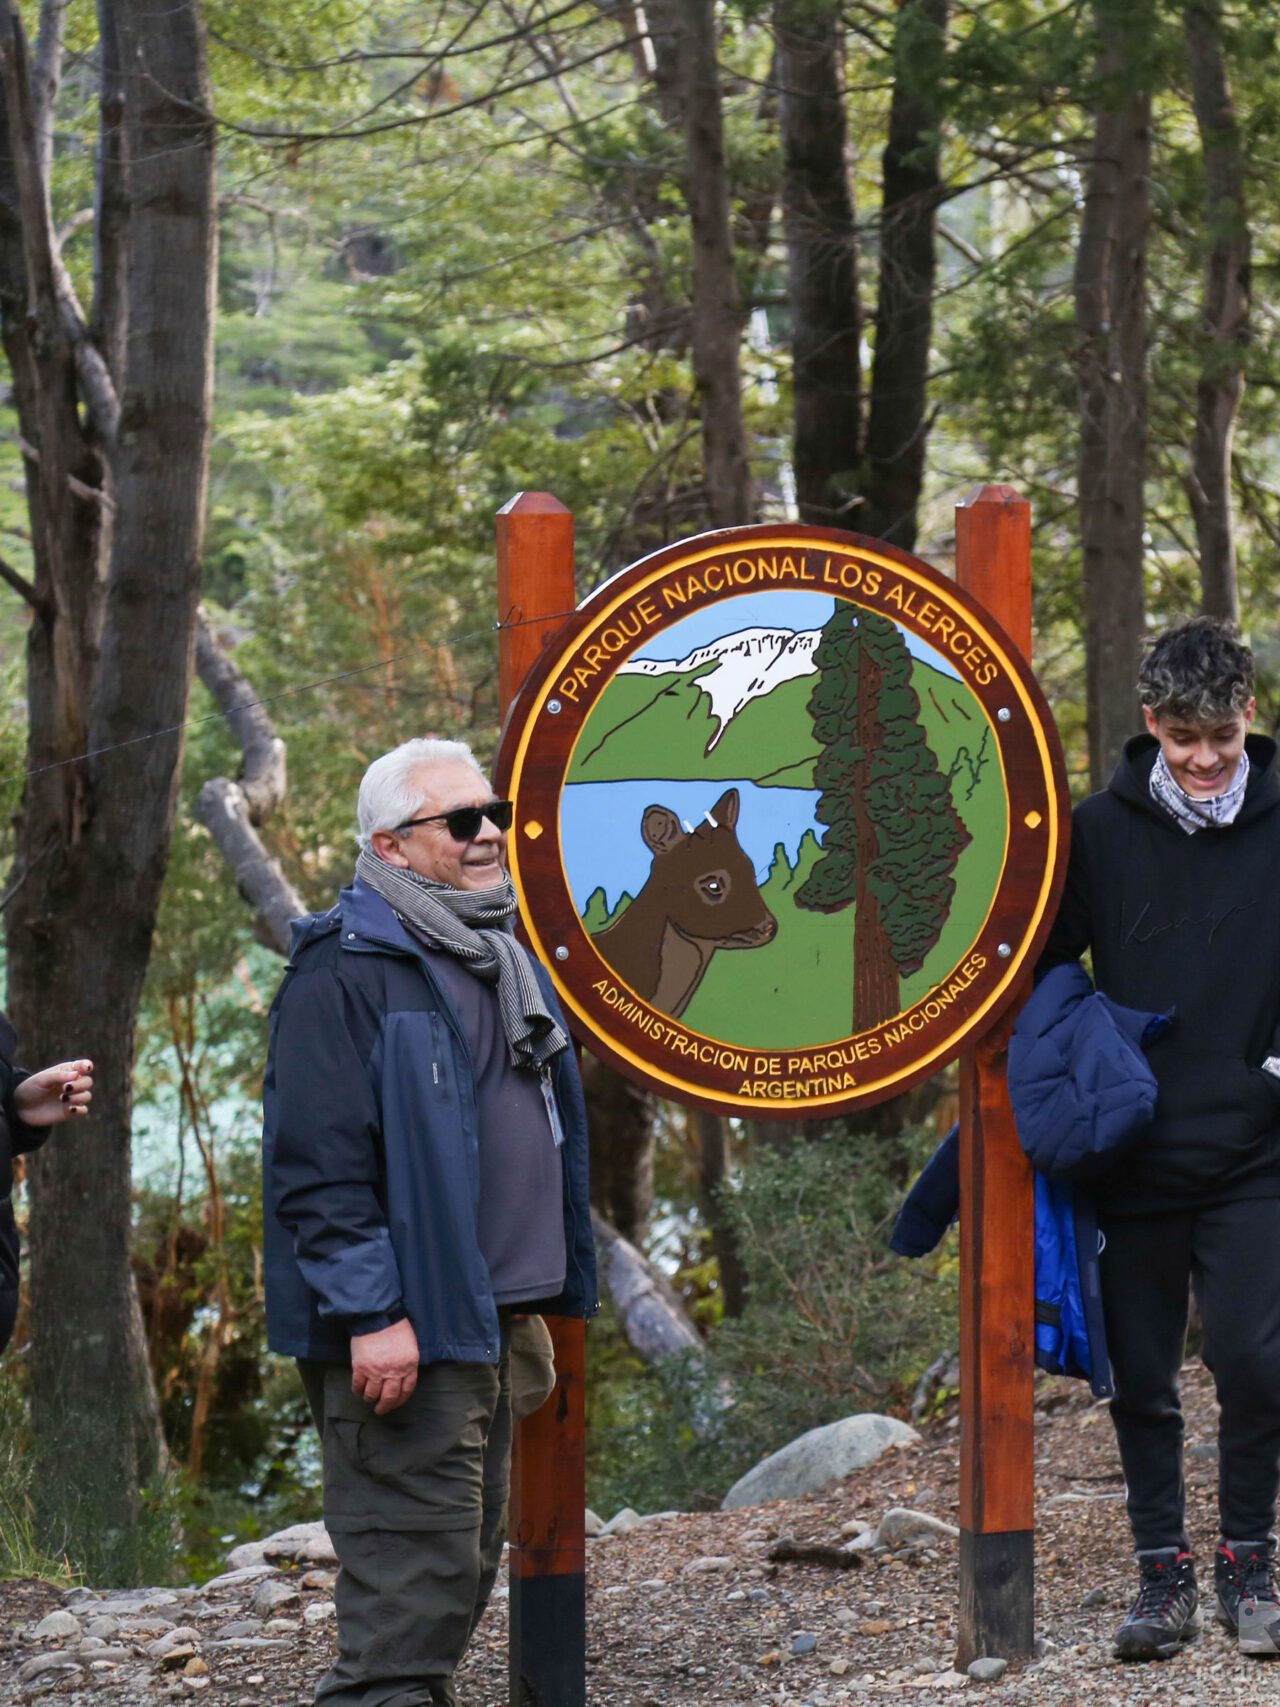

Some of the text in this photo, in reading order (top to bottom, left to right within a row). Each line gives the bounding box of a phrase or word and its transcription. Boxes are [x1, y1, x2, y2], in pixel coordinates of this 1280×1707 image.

[559, 555, 998, 702] PARQUE NACIONAL LOS ALERCES
[592, 953, 986, 1075] ADMINISTRACION DE PARQUES NACIONALES
[738, 1072, 856, 1098] ARGENTINA
